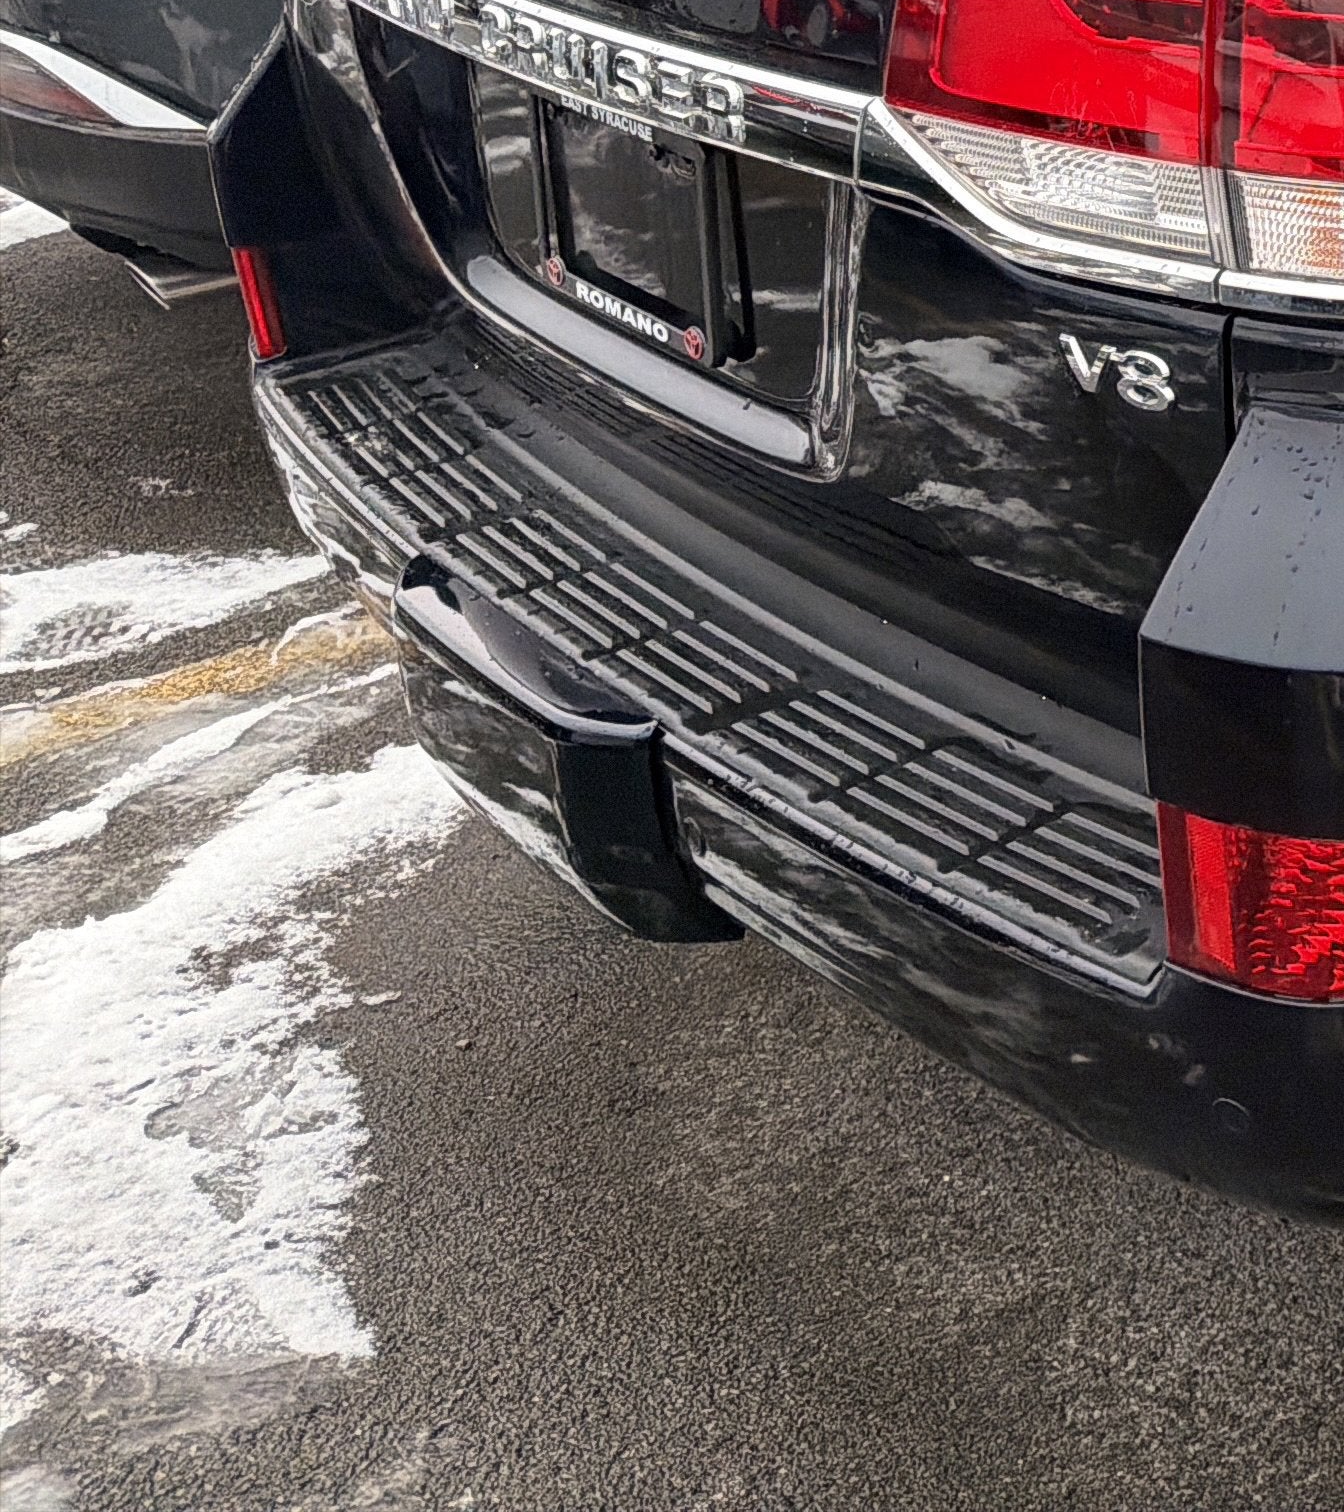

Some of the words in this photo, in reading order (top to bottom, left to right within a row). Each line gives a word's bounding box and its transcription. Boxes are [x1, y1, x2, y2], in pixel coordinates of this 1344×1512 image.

[479, 3, 747, 143] CRUISER
[560, 93, 588, 117] EAST
[591, 105, 654, 143] SYRACUSE
[575, 280, 669, 343] ROMANO
[1059, 333, 1175, 411] V8
